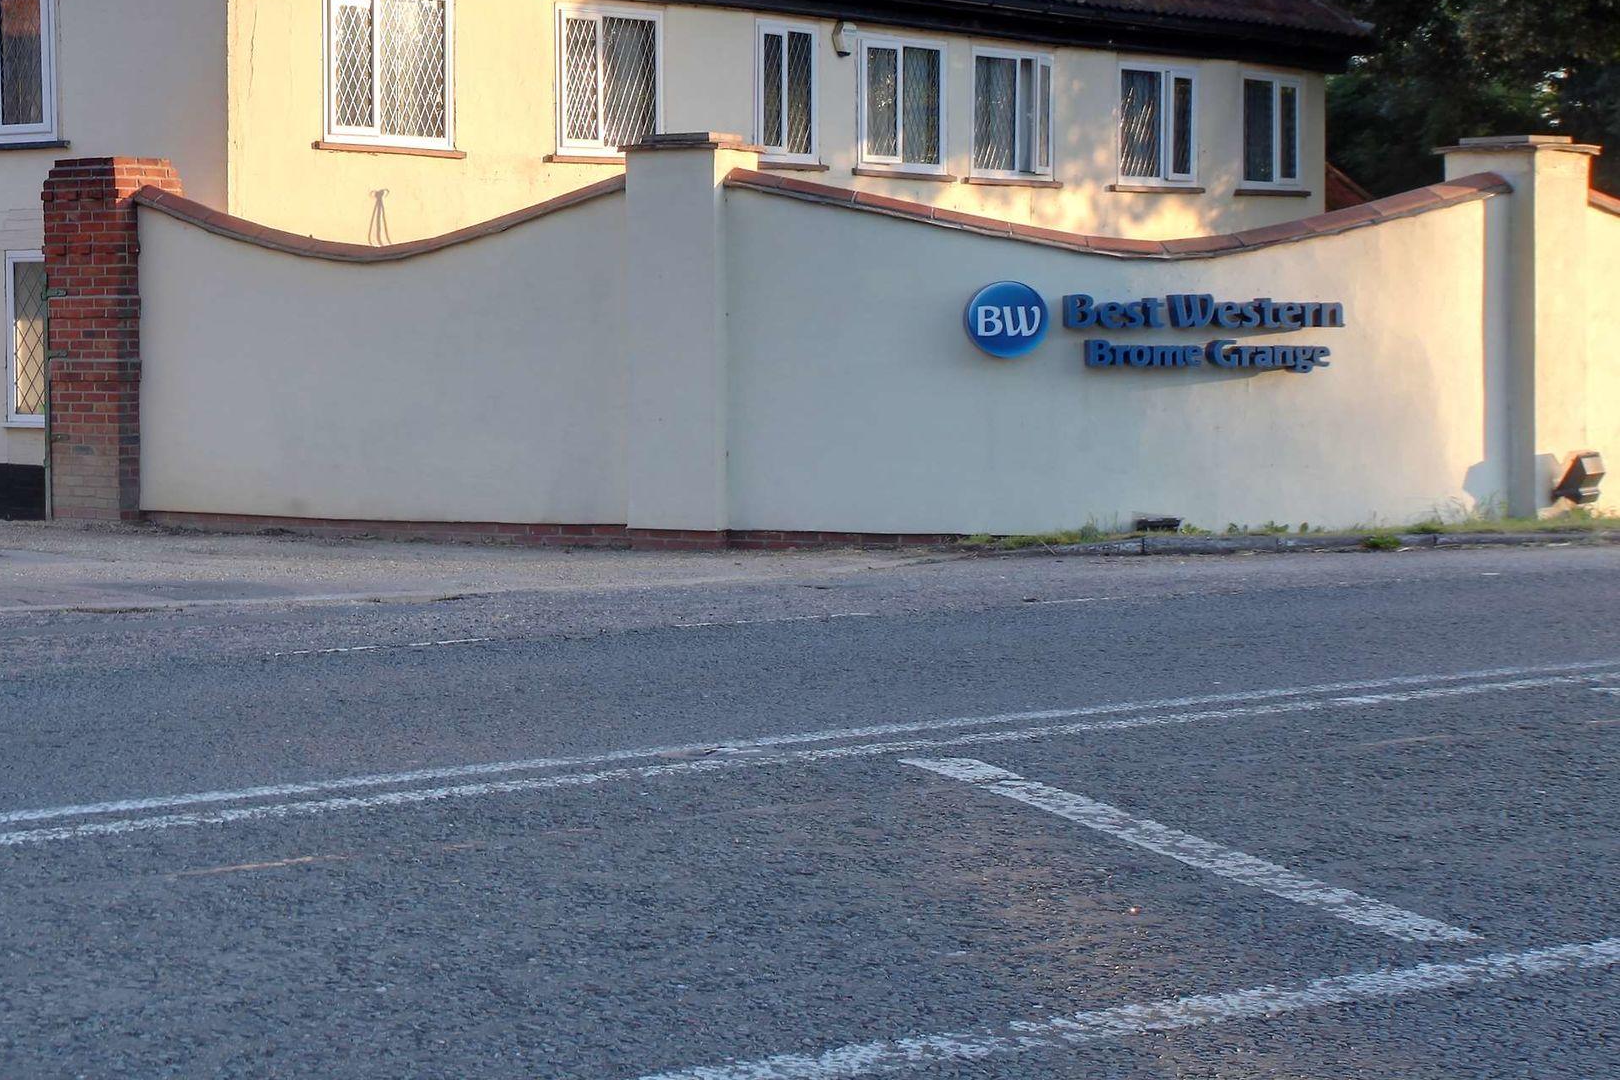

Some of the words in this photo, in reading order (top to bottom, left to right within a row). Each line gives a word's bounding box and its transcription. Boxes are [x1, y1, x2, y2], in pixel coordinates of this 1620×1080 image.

[977, 305, 1041, 337] BW
[1063, 294, 1165, 328] Best
[1166, 293, 1343, 328] Western
[1084, 339, 1202, 367] Brome
[1205, 339, 1330, 373] Grange
